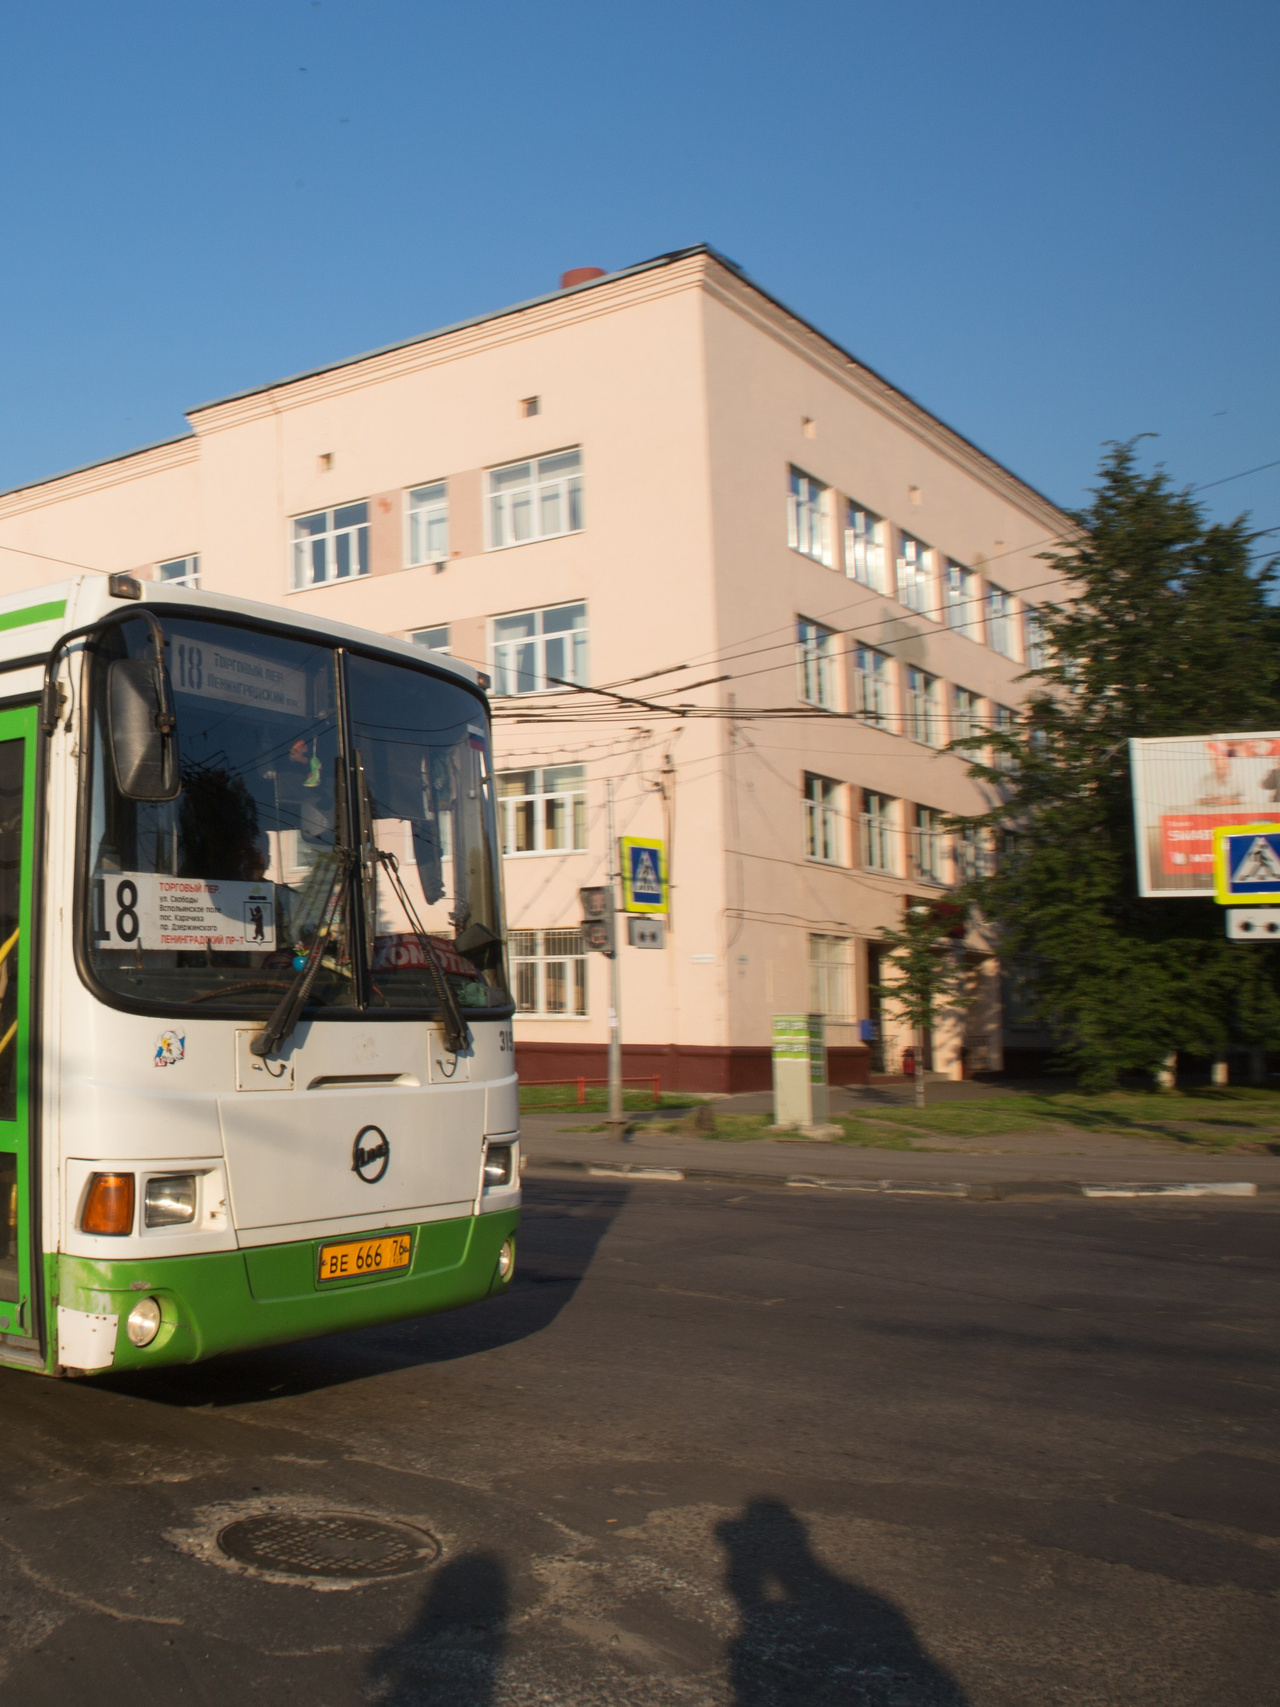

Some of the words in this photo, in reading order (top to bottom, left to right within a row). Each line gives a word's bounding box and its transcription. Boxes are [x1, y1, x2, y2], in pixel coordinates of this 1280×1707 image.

[178, 643, 204, 690] 18
[159, 882, 202, 893] ТОРГОВЫЙ
[170, 895, 199, 904] Свободы
[93, 878, 140, 943] 18
[174, 914, 205, 923] Карачиха
[172, 923, 218, 932] Дзержинского
[160, 934, 224, 946] ЛЕНИНГРАДСКИЙ
[225, 936, 245, 945] ПР-Т
[355, 1243, 383, 1270] 666
[392, 1239, 405, 1257] 76
